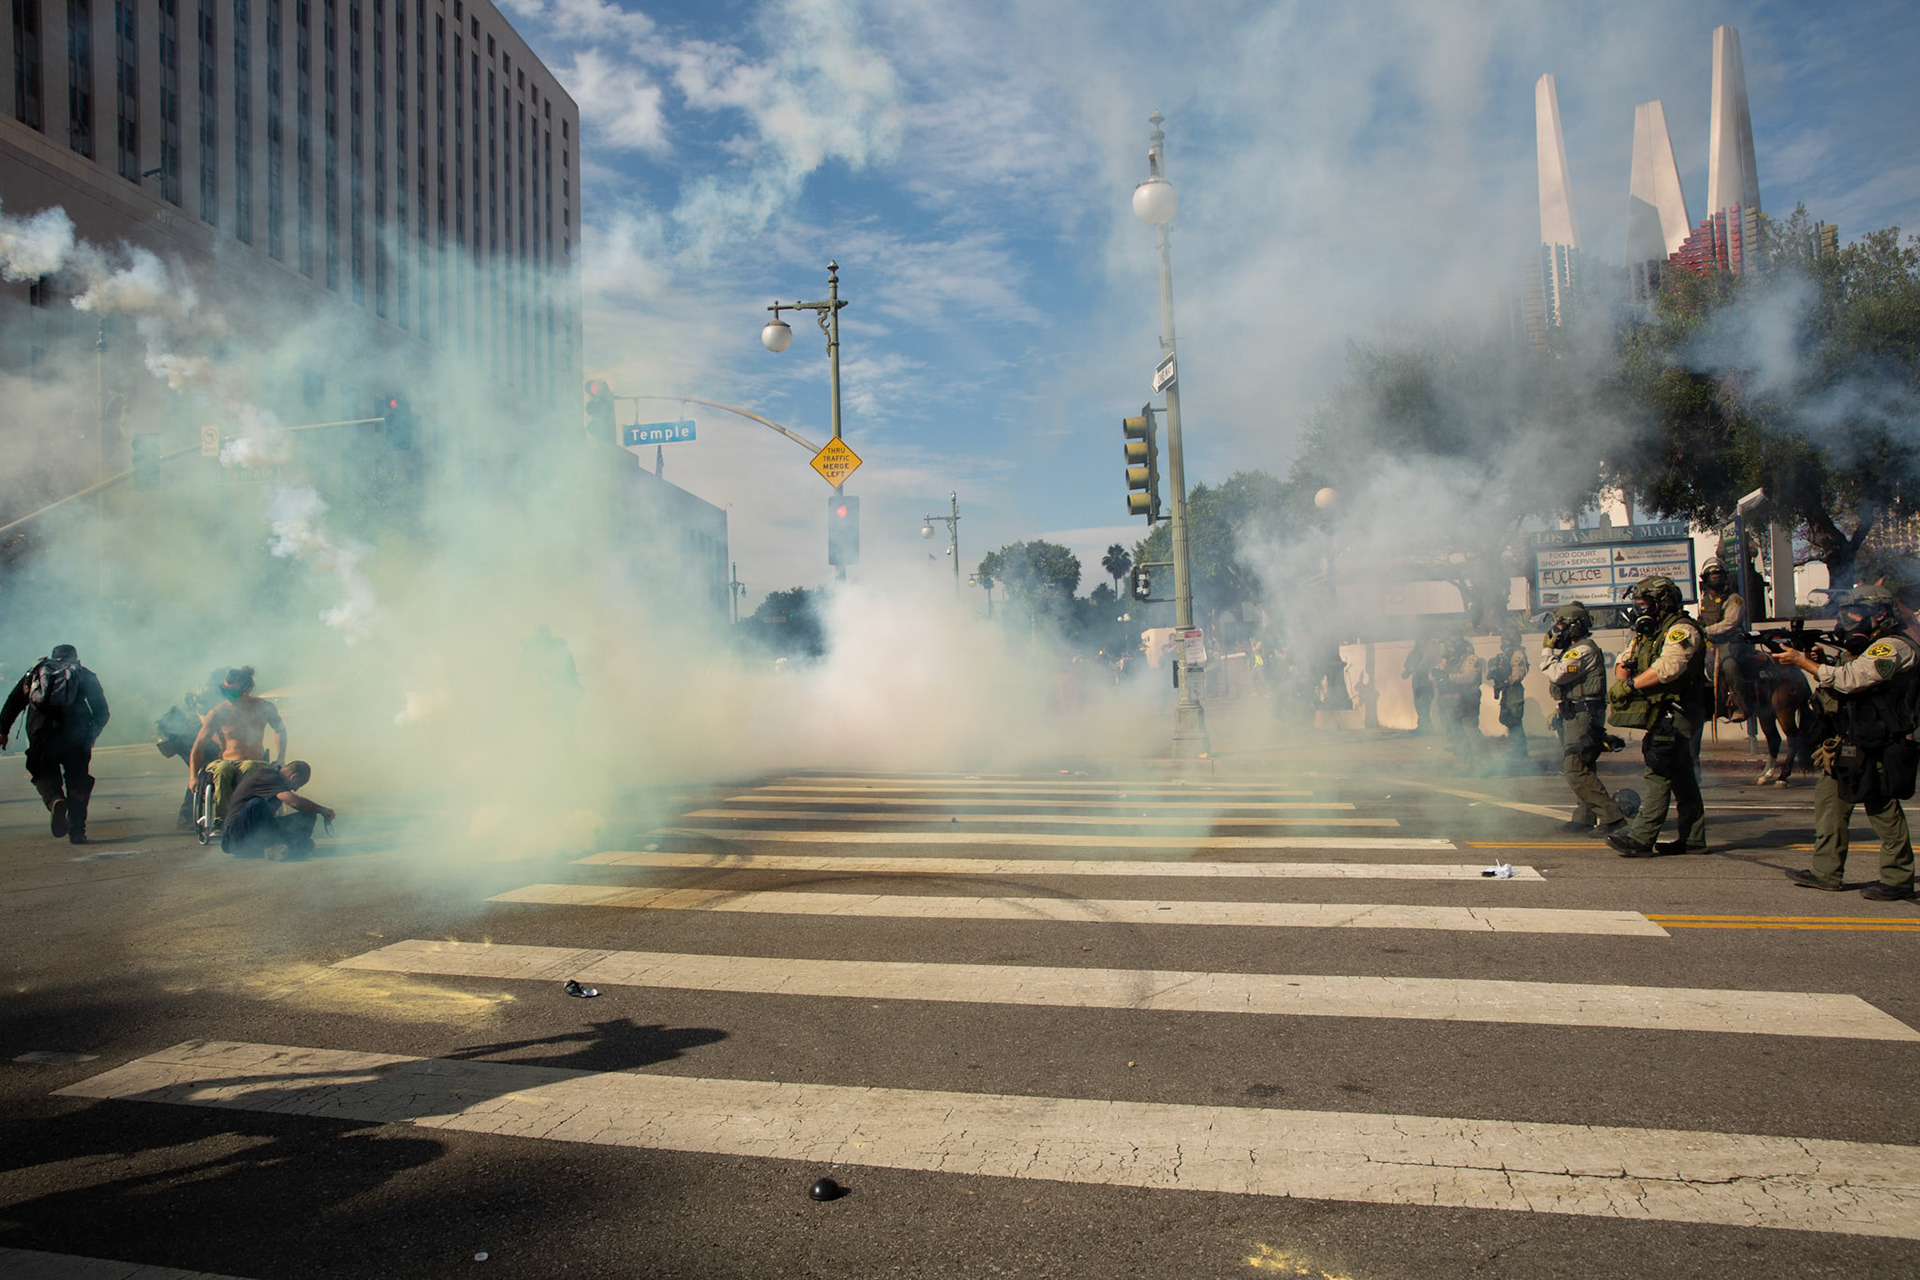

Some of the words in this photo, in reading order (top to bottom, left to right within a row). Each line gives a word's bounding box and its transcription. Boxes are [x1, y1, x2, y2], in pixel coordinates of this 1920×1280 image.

[631, 426, 689, 441] Temple
[1537, 532, 1564, 544] LOS
[1570, 529, 1634, 542] ANGELES
[1639, 524, 1681, 538] MALL
[1571, 550, 1597, 558] COURT
[1571, 558, 1607, 566] SERVICES
[1543, 570, 1578, 585] FUCK
[1577, 569, 1602, 581] ICE
